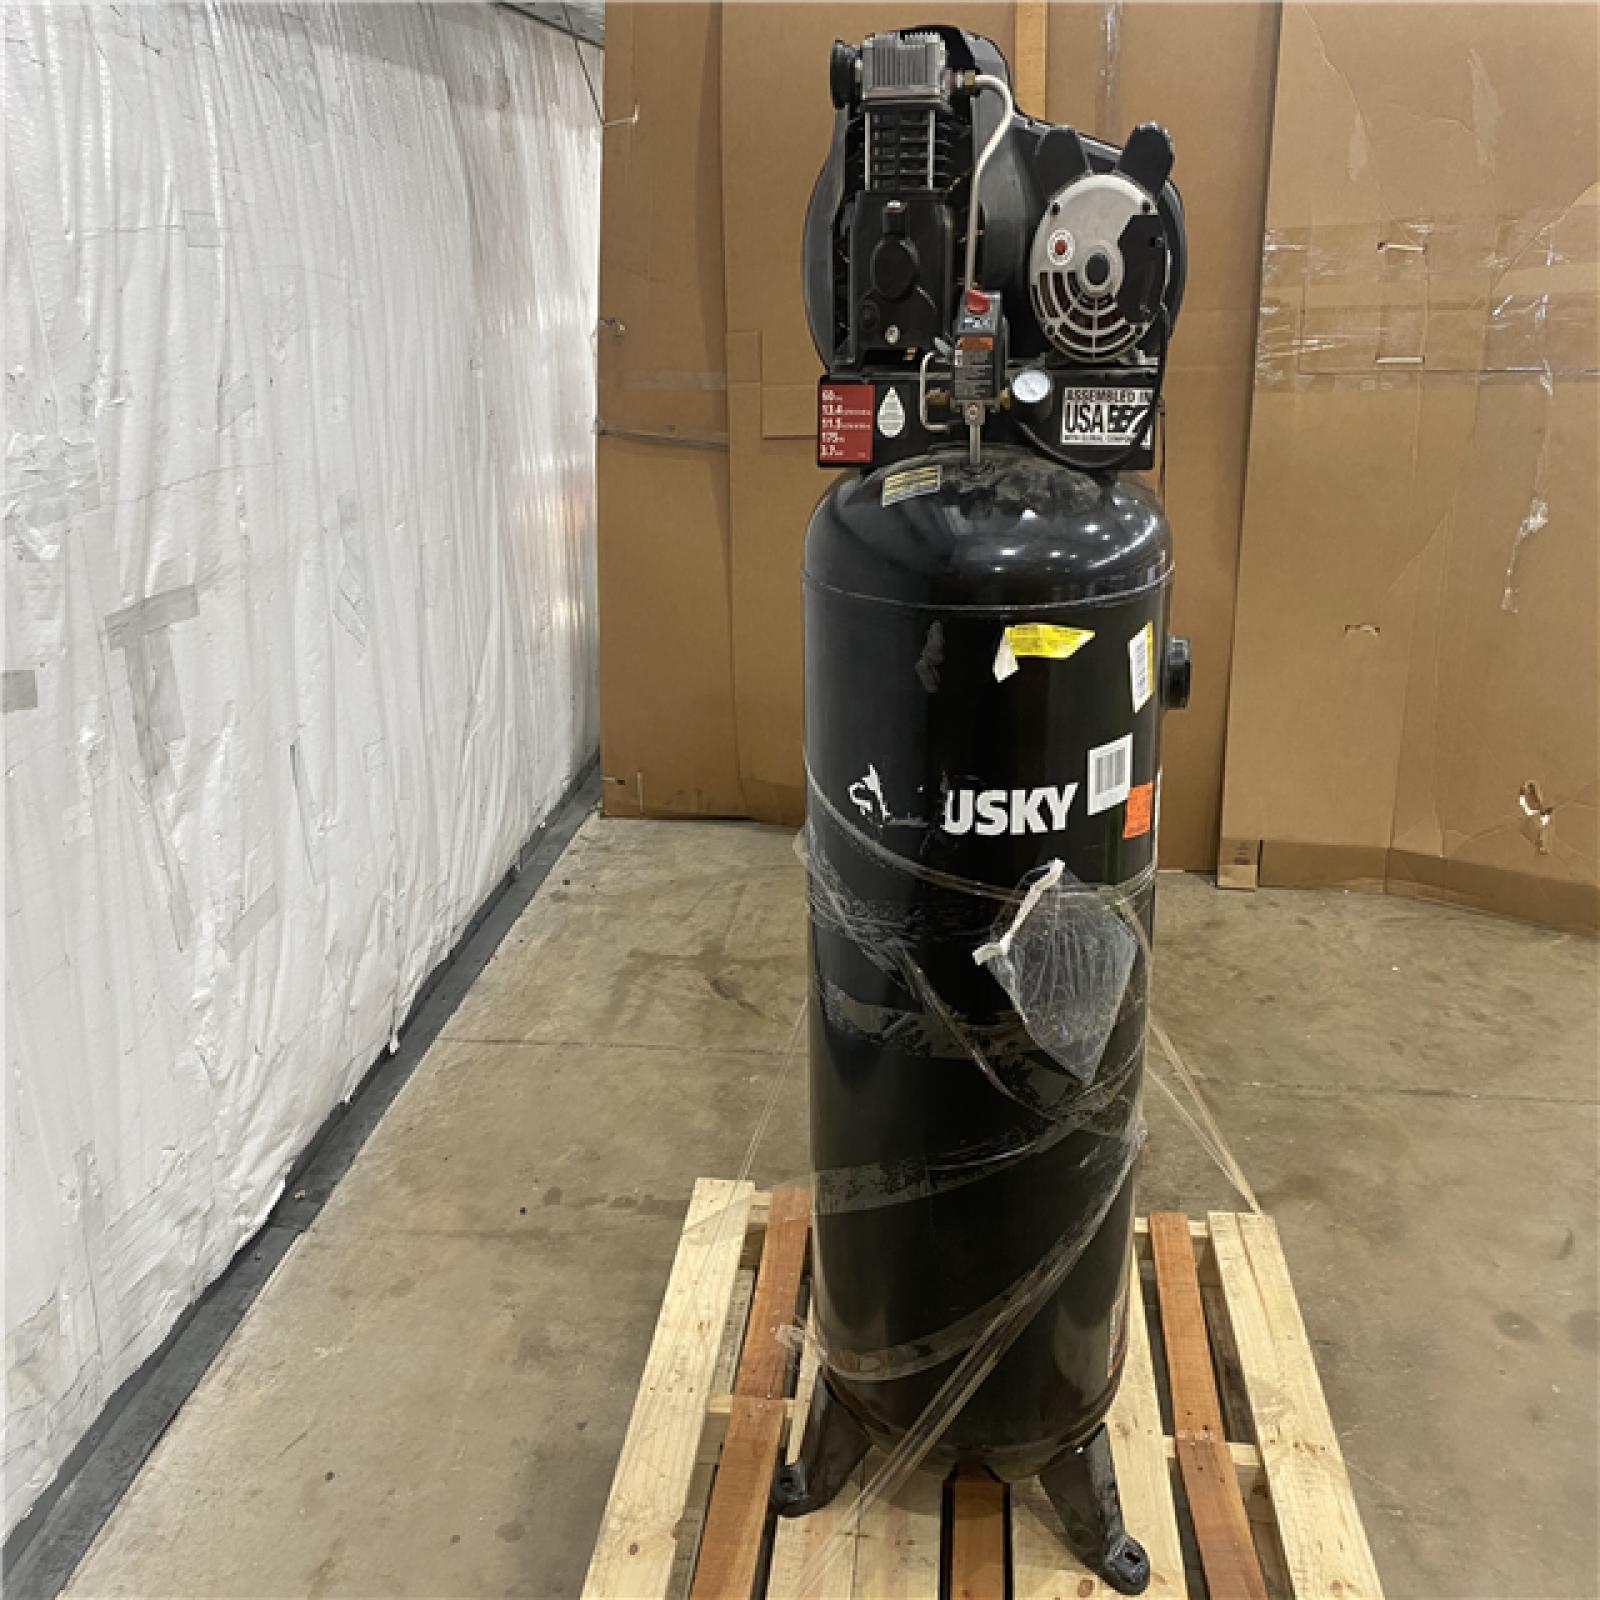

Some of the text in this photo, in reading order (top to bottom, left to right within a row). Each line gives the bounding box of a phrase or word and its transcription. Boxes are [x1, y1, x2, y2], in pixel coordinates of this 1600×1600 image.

[1065, 388, 1136, 402] ASSEMBLED
[1064, 404, 1103, 433] USA
[943, 782, 1078, 835] USKY
